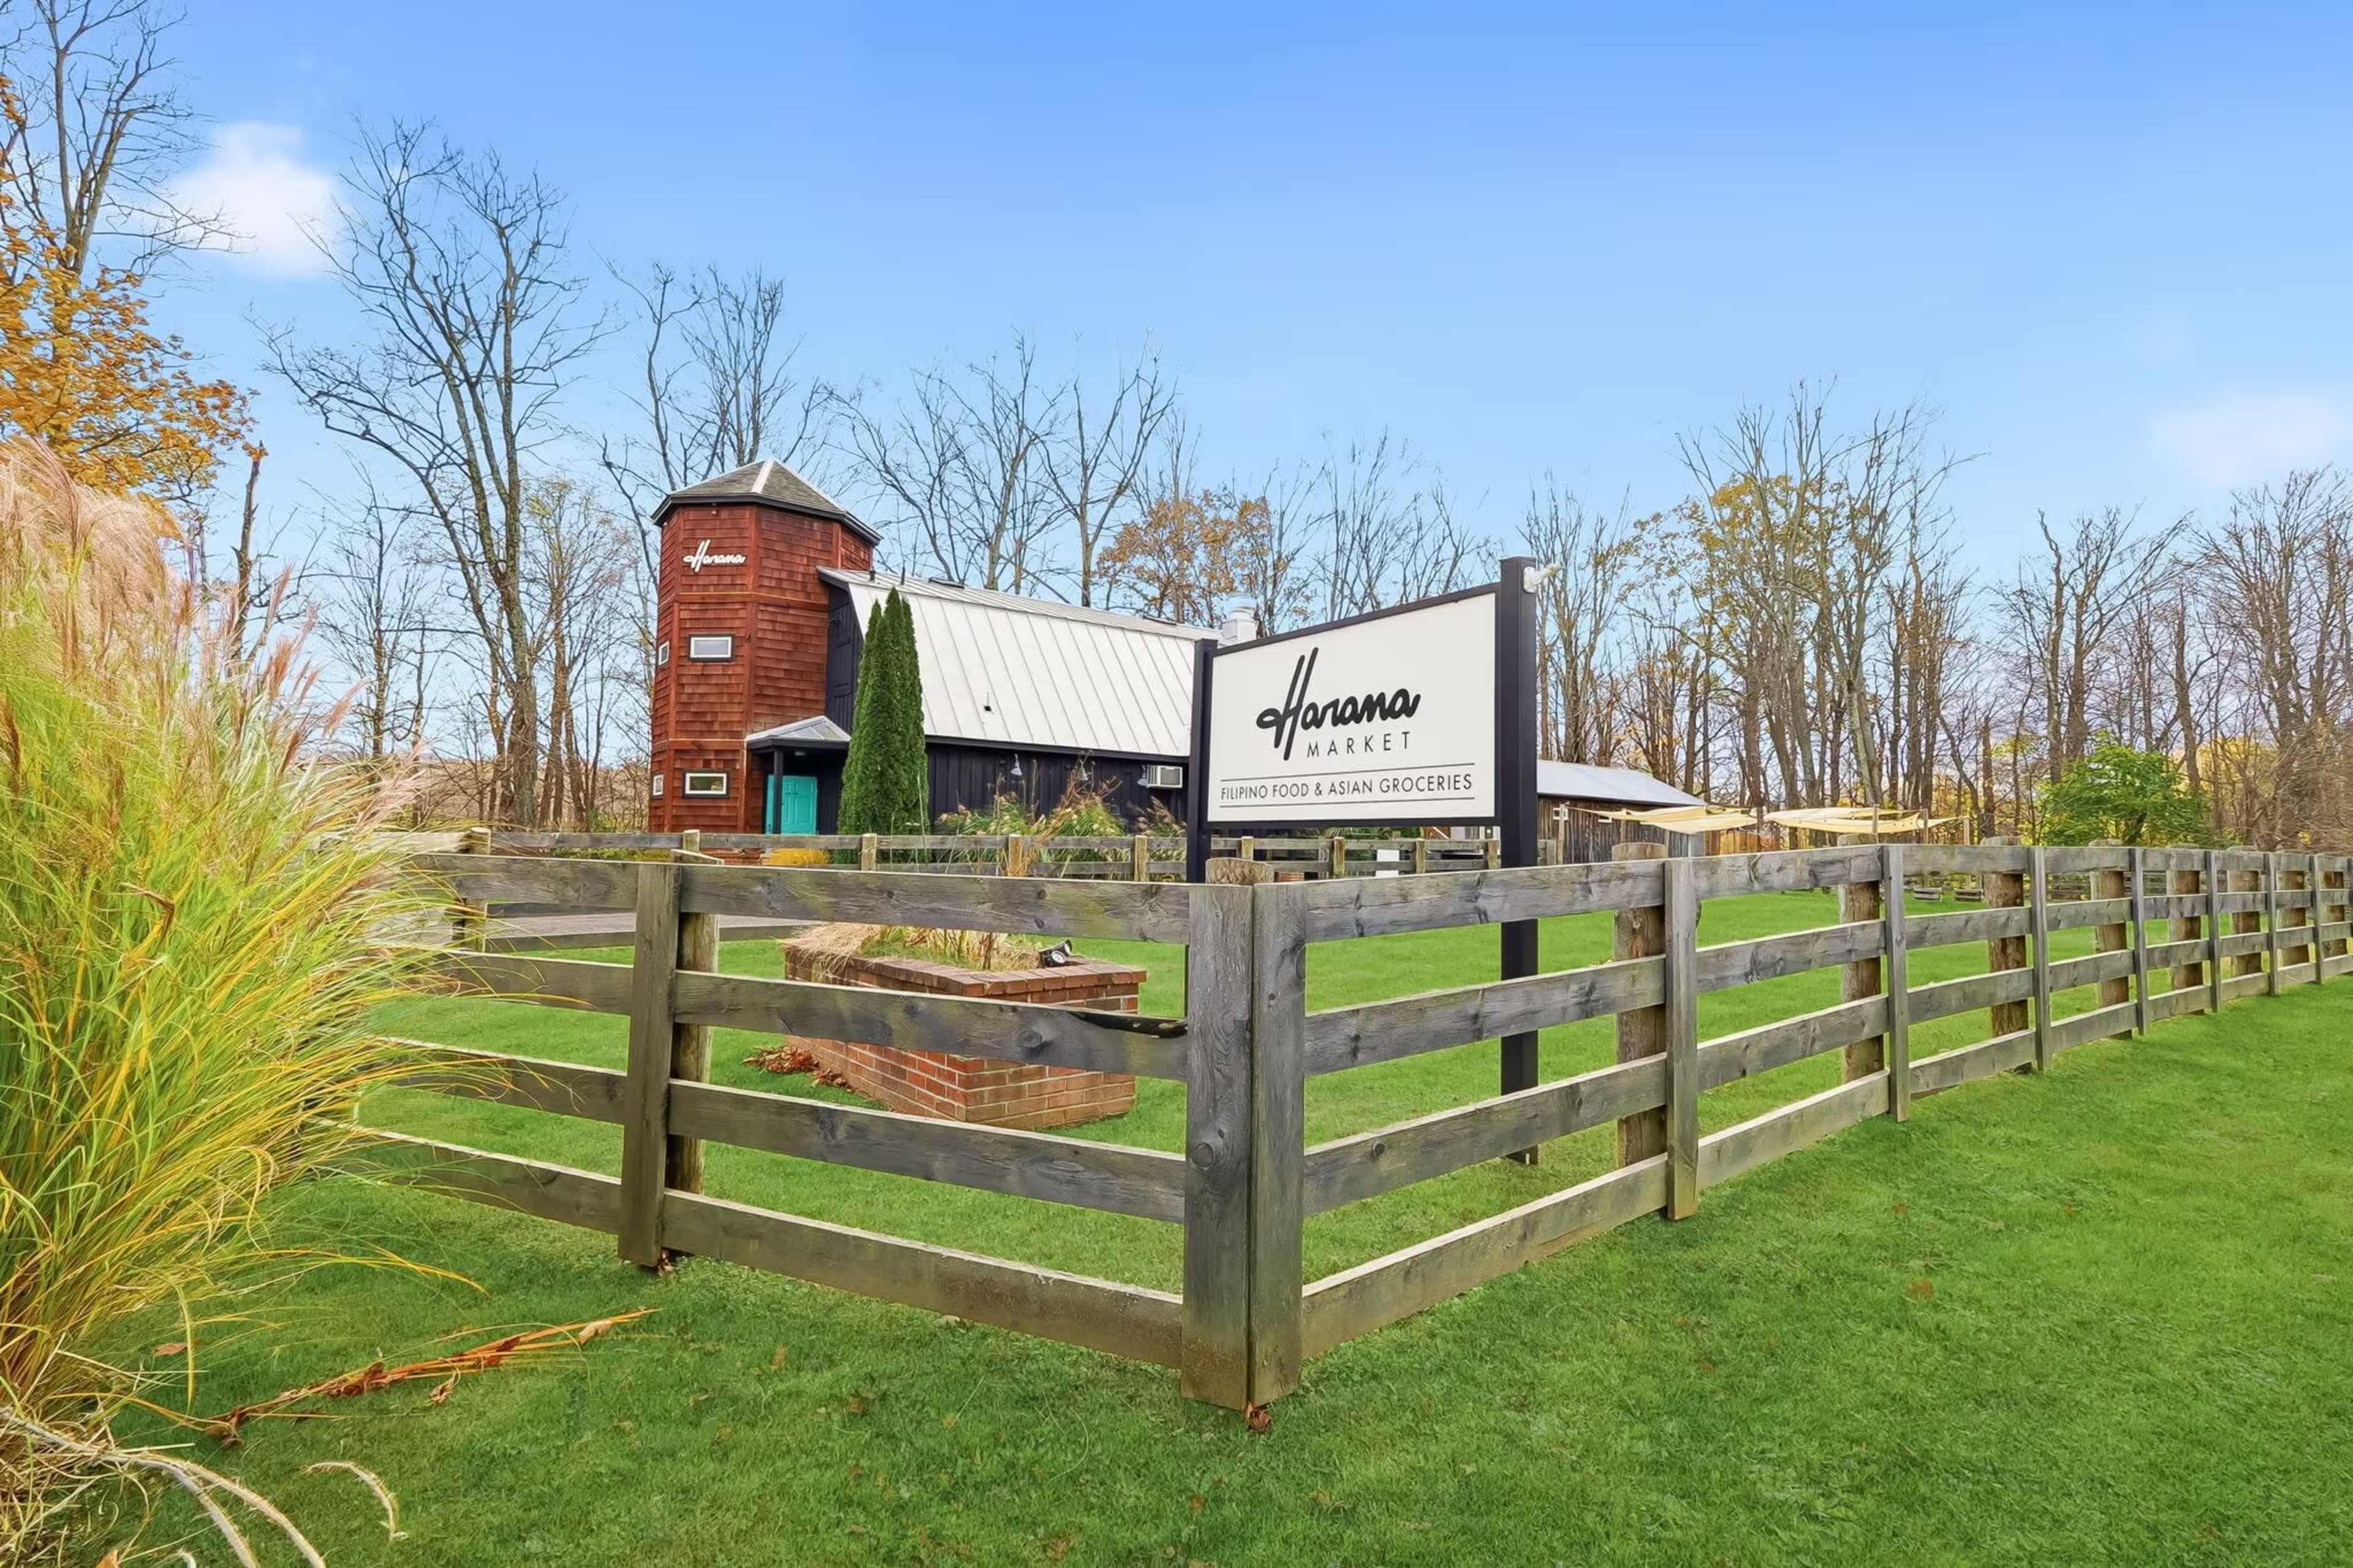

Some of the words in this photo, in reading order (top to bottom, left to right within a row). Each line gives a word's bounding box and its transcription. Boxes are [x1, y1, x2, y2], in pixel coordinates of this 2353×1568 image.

[683, 539, 746, 572] Harana
[1256, 646, 1421, 761] Harana
[1306, 731, 1410, 758] MARKET
[1221, 785, 1268, 800] FILIPINO
[1273, 783, 1309, 798] FOOD
[1314, 782, 1322, 797] &
[1328, 780, 1373, 795] ASIAN
[1379, 773, 1472, 793] GROCERIES
